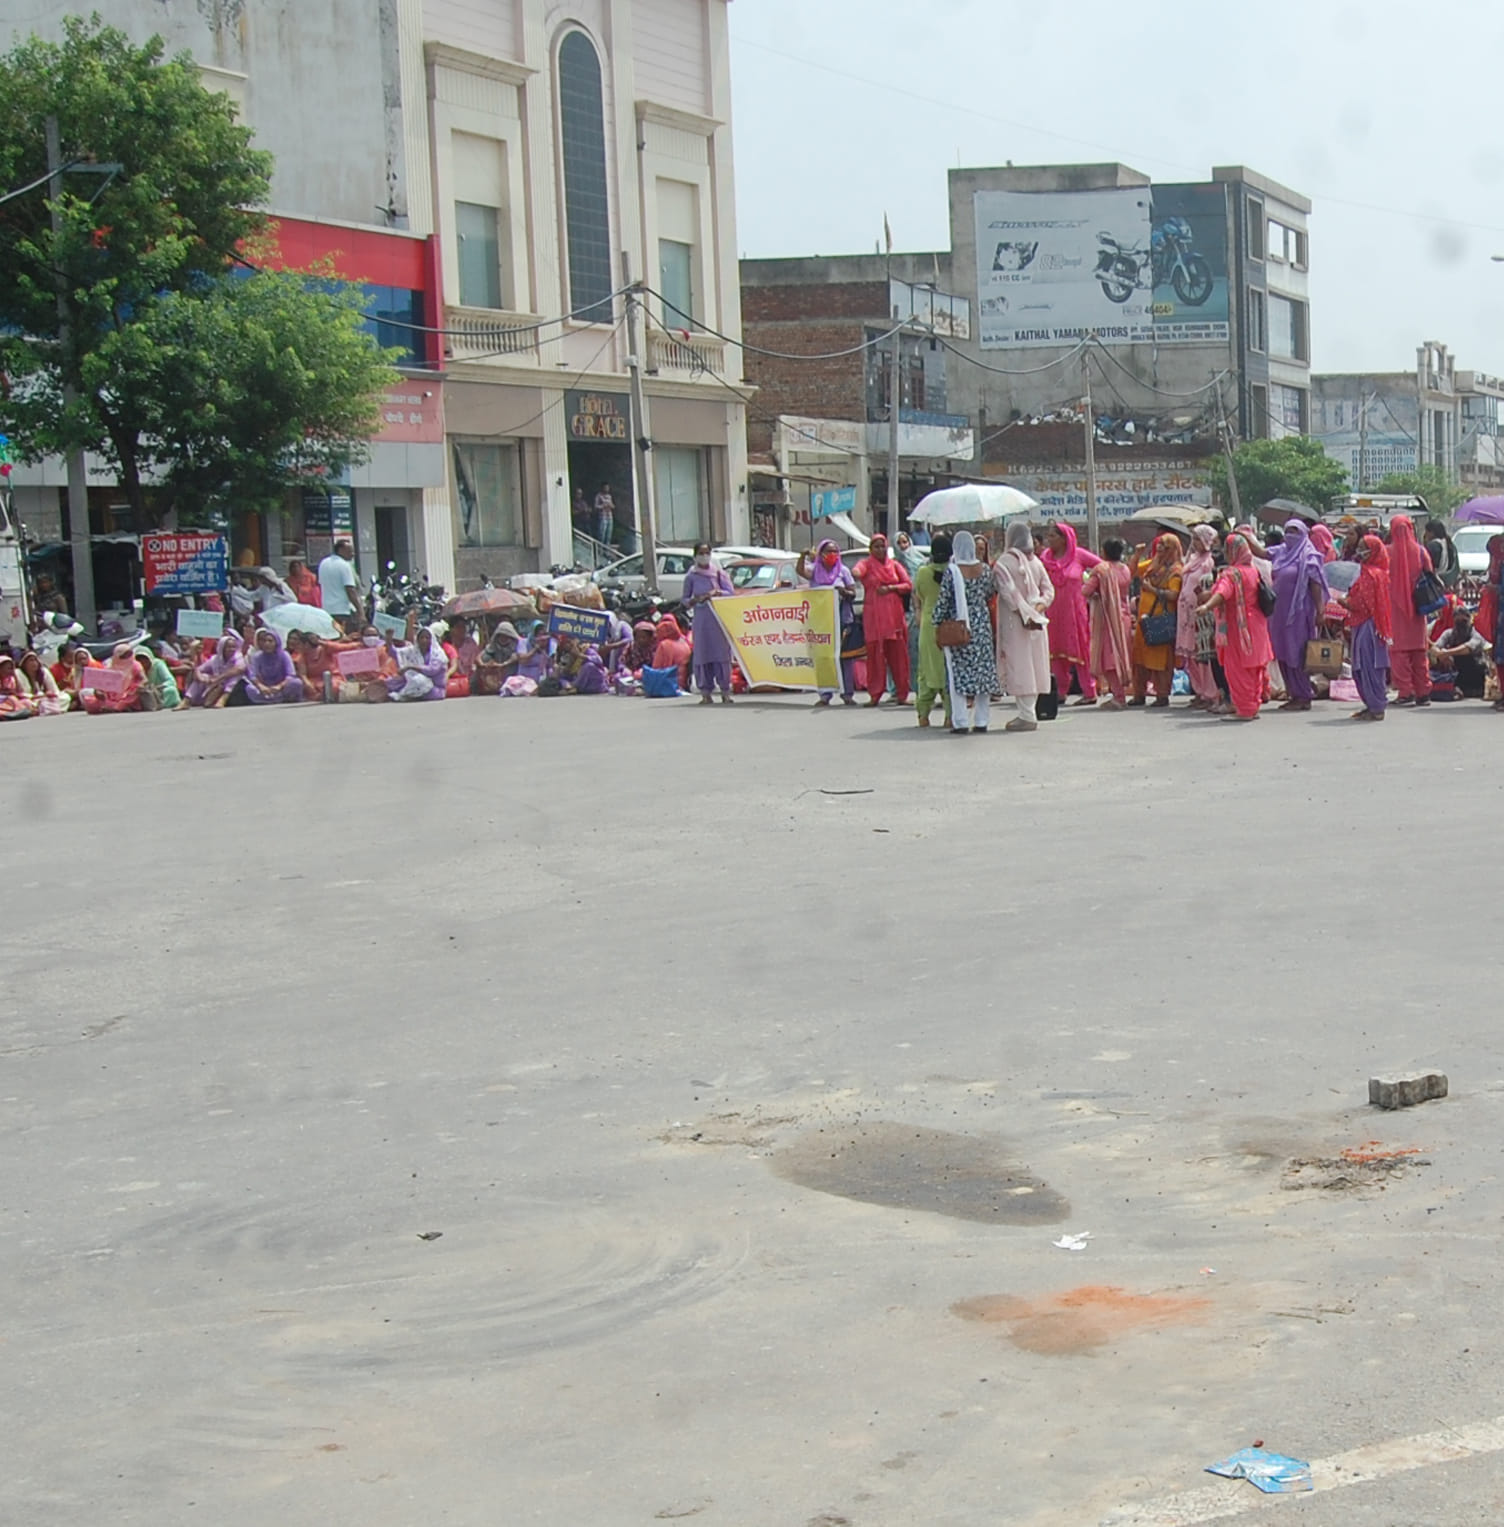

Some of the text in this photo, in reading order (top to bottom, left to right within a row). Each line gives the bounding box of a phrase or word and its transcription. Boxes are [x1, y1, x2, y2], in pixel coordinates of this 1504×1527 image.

[1014, 329, 1051, 341] KAITHAL
[1091, 326, 1129, 339] MOTORS
[571, 414, 626, 438] GRACE
[162, 537, 218, 552] NO ENTRY
